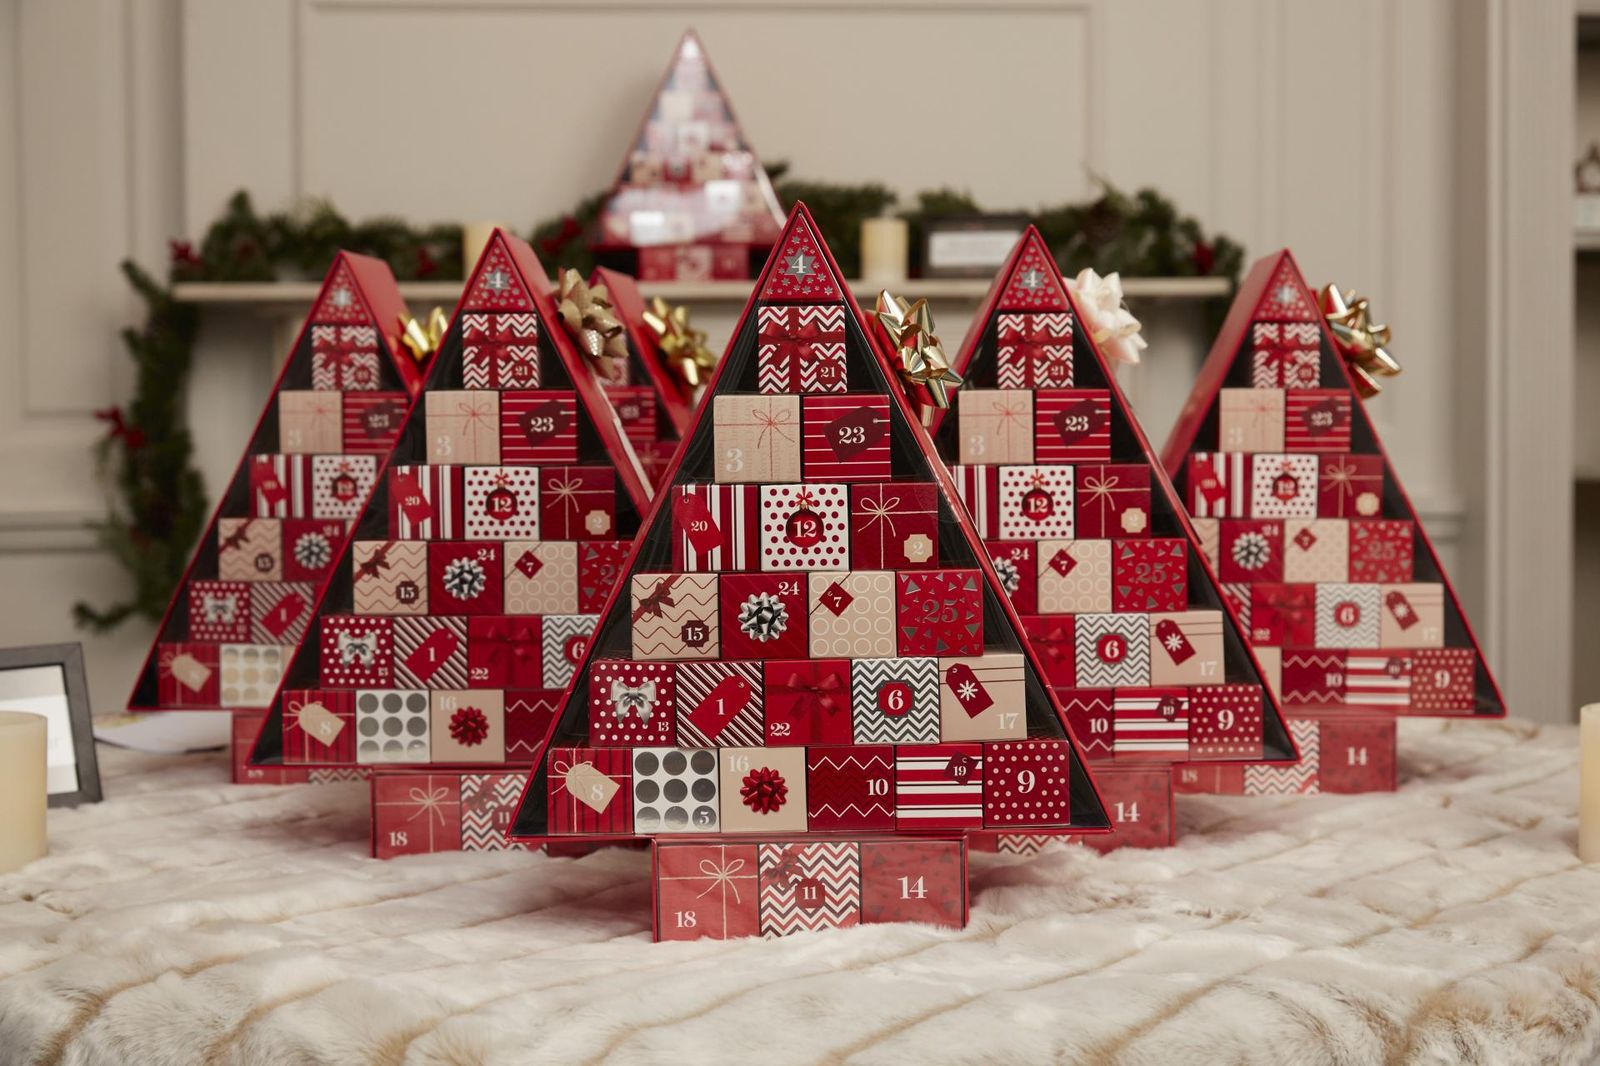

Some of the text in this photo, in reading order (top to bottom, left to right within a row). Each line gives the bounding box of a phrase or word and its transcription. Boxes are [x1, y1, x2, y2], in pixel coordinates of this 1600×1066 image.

[791, 254, 807, 274] 4
[1025, 271, 1038, 287] 4
[515, 366, 528, 376] 21
[820, 367, 836, 378] 21
[1051, 366, 1064, 376] 21
[531, 417, 554, 432] 23
[1066, 416, 1089, 431] 23
[838, 426, 866, 444] 23
[436, 436, 451, 456] 3
[970, 436, 984, 455] 3
[725, 448, 744, 472] 3
[405, 497, 420, 506] 20
[491, 496, 512, 512] 12
[1029, 498, 1048, 513] 12
[592, 517, 602, 529] 2
[691, 520, 708, 532] 20
[1129, 514, 1138, 525] 2
[793, 520, 817, 538] 12
[478, 549, 496, 561] 24
[913, 541, 924, 555] 2
[1011, 548, 1029, 560] 24
[526, 562, 534, 572] 7
[1060, 561, 1068, 570] 7
[1135, 563, 1166, 584] 25
[400, 586, 415, 598] 15
[778, 581, 800, 595] 24
[833, 596, 842, 608] 7
[921, 598, 958, 623] 25
[685, 627, 704, 641] 15
[428, 648, 436, 662] 1
[572, 642, 584, 659] 6
[1105, 640, 1119, 659] 6
[471, 668, 489, 679] 22
[1200, 661, 1217, 676] 17
[1434, 670, 1450, 687] 9
[716, 698, 726, 716] 1
[887, 689, 904, 710] 6
[1163, 706, 1174, 715] 19
[657, 721, 669, 731] 13
[997, 713, 1019, 729] 17
[1089, 718, 1108, 733] 10
[1217, 709, 1234, 730] 9
[320, 721, 332, 736] 8
[770, 722, 791, 736] 22
[728, 754, 750, 773] 16
[1347, 747, 1368, 766] 14
[953, 765, 967, 777] 19
[866, 778, 889, 796] 10
[1017, 769, 1036, 794] 9
[591, 783, 604, 801] 8
[699, 811, 710, 825] 5
[1115, 802, 1140, 822] 14
[389, 832, 408, 846] 18
[802, 886, 817, 900] 11
[897, 875, 928, 899] 14
[675, 911, 697, 928] 18
